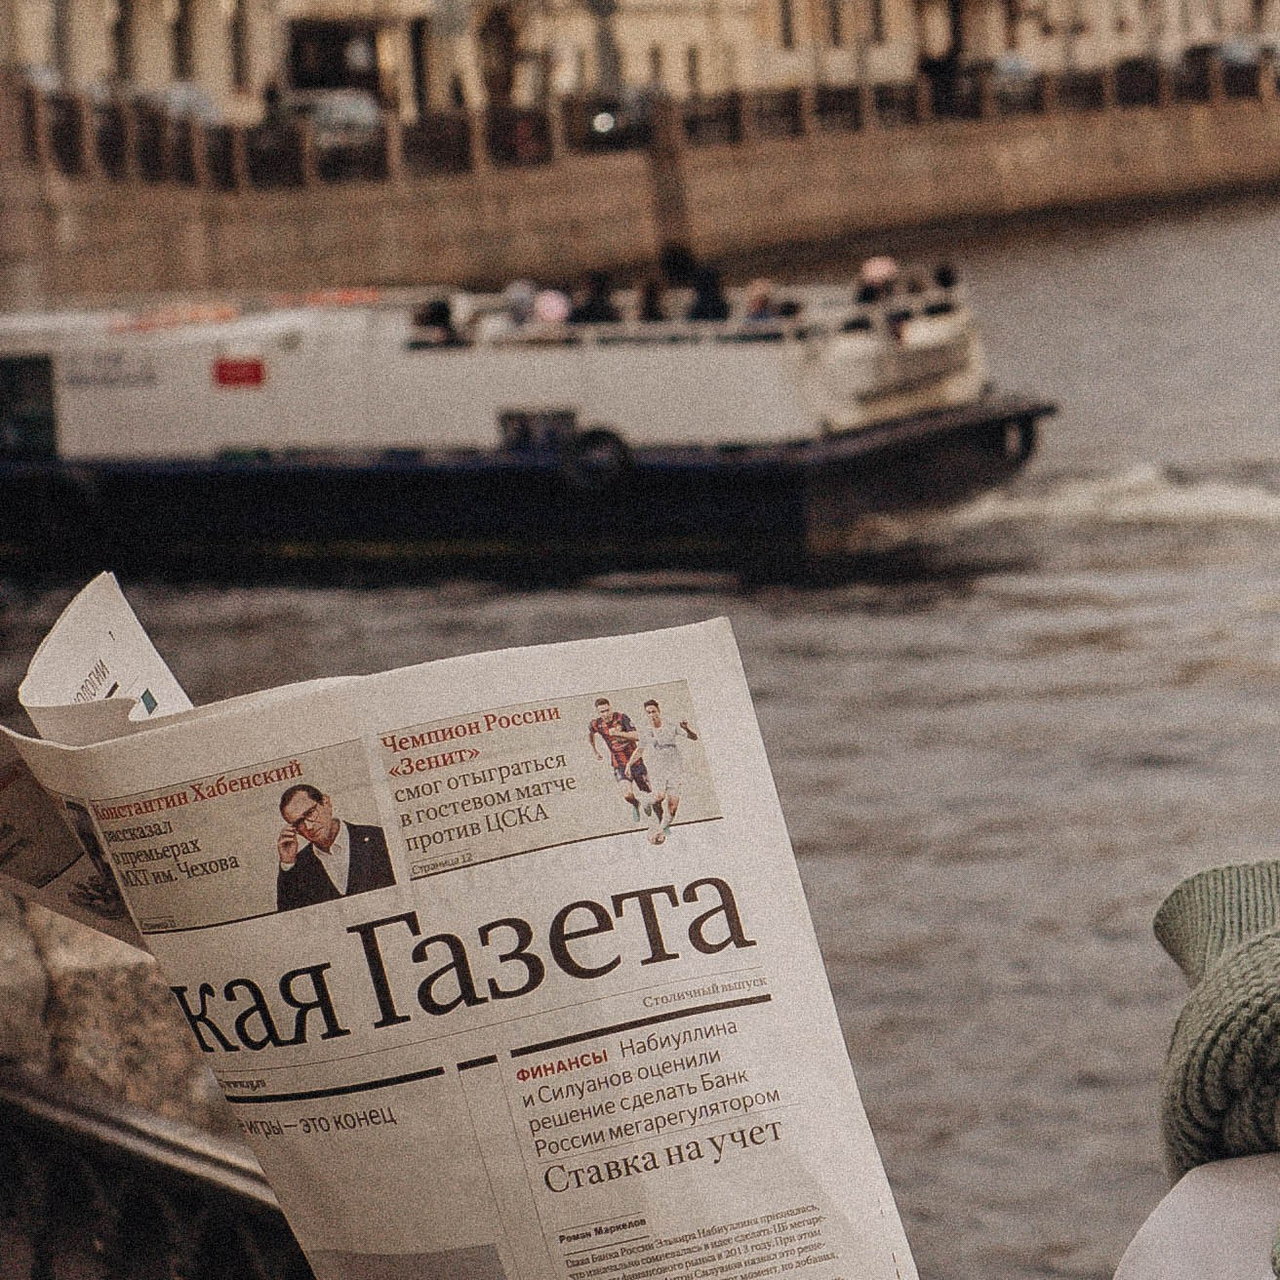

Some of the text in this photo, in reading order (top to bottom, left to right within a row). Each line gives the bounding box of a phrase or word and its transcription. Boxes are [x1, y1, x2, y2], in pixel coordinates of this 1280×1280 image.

[382, 706, 562, 754] Чемпион России
[191, 759, 303, 803] Хабенский
[388, 747, 481, 778] «Зенит»
[394, 753, 567, 803] смог отыграться
[401, 776, 577, 828] в гостевом матче
[122, 836, 202, 870] премьерах
[406, 803, 550, 853] против ЦСКА
[153, 866, 178, 884] им.
[178, 856, 240, 879] Чехова
[411, 852, 474, 876] Страница 12
[347, 877, 757, 1029] Газета
[642, 976, 768, 1008] Столичный выпуск
[516, 1020, 738, 1083] ФИНАНСЫ Набиуллина
[523, 1048, 722, 1108] и Силуанов оценили
[529, 1068, 749, 1137] решение сделать Банк
[302, 1116, 330, 1134] это
[335, 1106, 398, 1132] конец
[535, 1088, 781, 1158] России мегарегулятором
[543, 1121, 783, 1194] Ставка на учет
